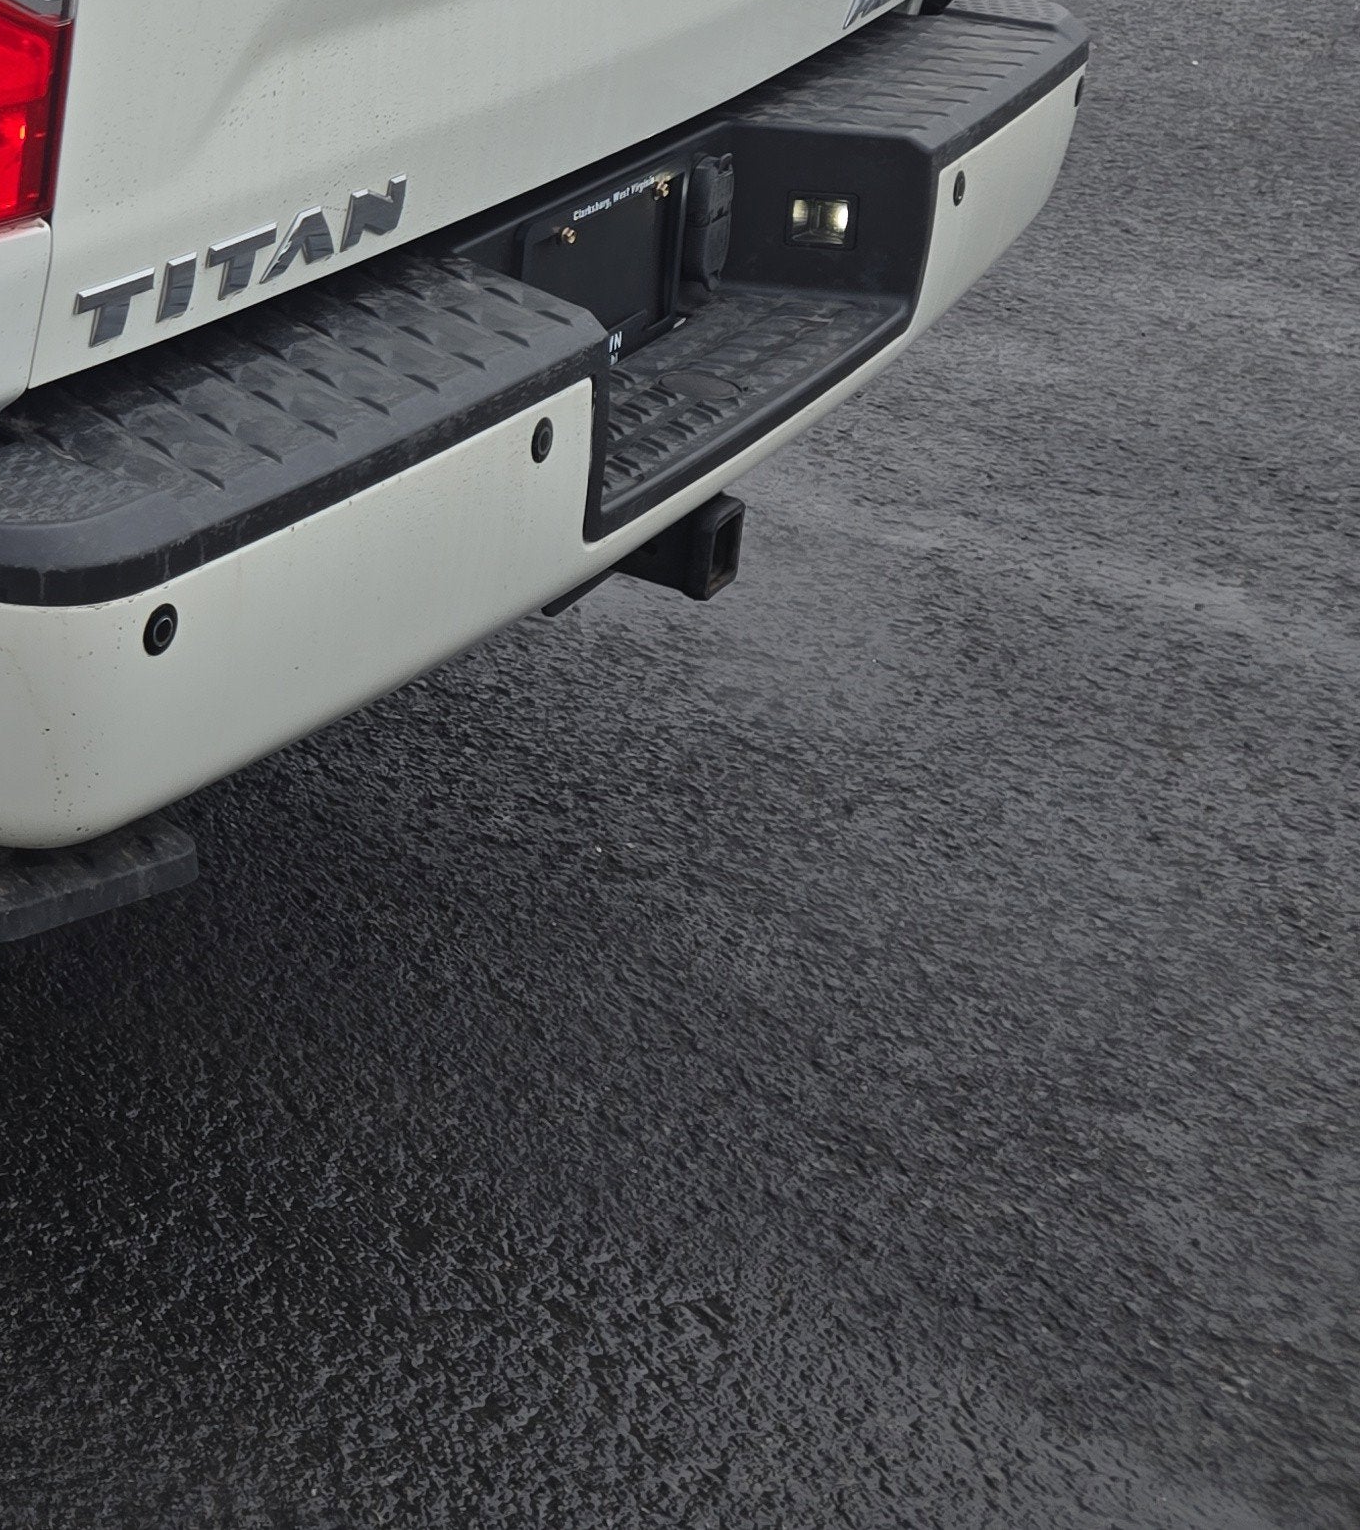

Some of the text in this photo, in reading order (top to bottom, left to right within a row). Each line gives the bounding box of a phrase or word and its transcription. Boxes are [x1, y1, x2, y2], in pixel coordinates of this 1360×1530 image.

[612, 186, 630, 203] West
[631, 175, 655, 194] Virginia
[73, 172, 407, 348] TITAN
